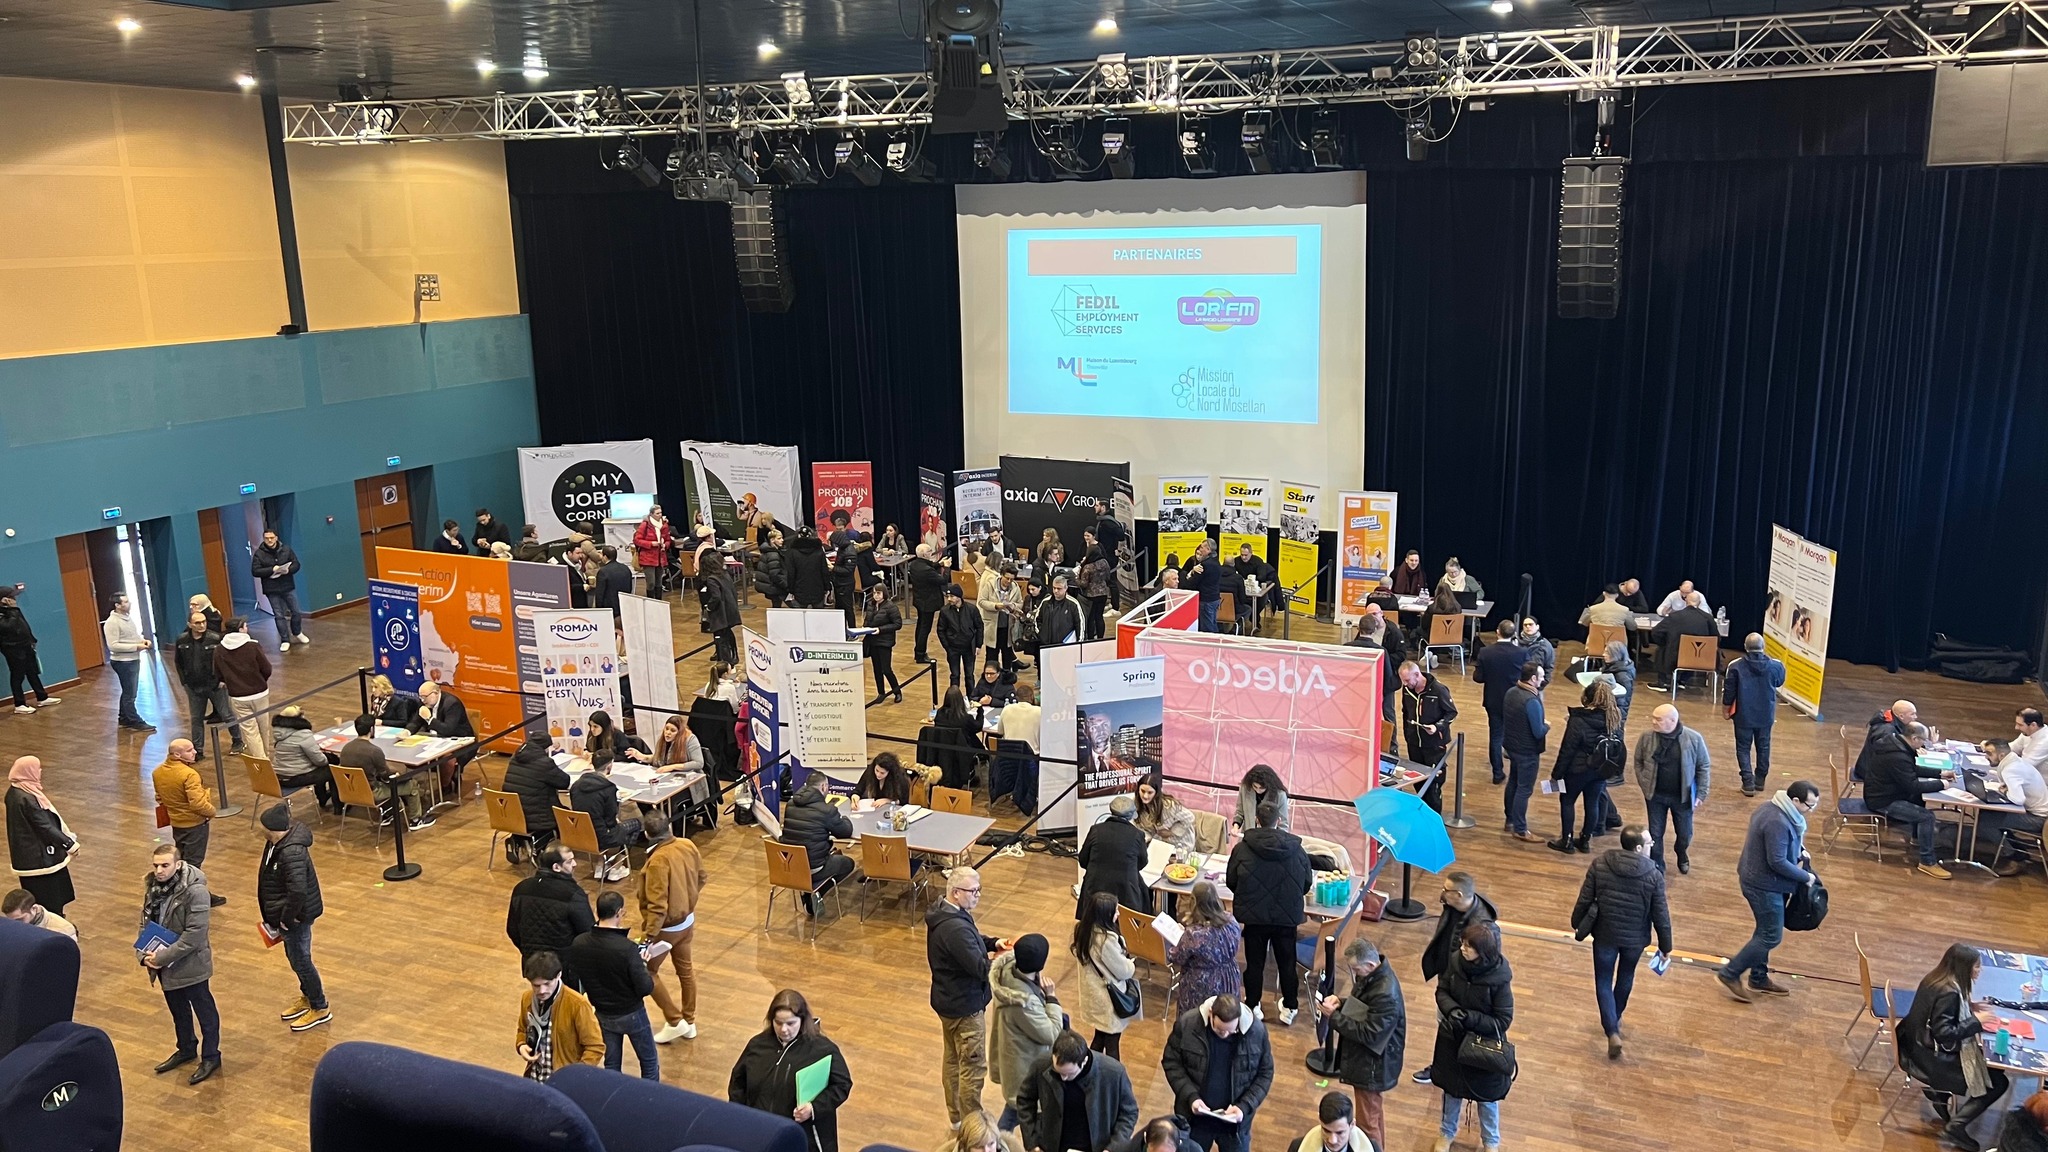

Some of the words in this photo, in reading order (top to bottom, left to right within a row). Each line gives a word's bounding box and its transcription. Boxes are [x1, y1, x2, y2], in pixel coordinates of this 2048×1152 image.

[1113, 248, 1202, 260] PARTENAIRES
[1076, 295, 1119, 309] FEDIL
[1076, 313, 1139, 322] EMPLOYMENT
[1076, 325, 1123, 334] SERVICES
[1198, 367, 1234, 382] Mission
[1198, 383, 1227, 397] Locale
[1229, 384, 1241, 397] du
[1197, 397, 1221, 411] Nord
[1223, 399, 1265, 413] Mosellan
[818, 487, 868, 497] PROCHAIN
[1168, 485, 1202, 494] Staff
[1229, 486, 1263, 496] Staff
[565, 490, 623, 508] JOB'
[831, 497, 853, 507] JOB
[856, 496, 864, 508] ?
[921, 493, 945, 509] PROCHAIN
[1004, 487, 1039, 503] axia
[1072, 495, 1115, 509] GROE
[1287, 491, 1315, 503] Staff
[566, 510, 612, 522] CORNE
[1778, 532, 1796, 547] Morgan
[1805, 547, 1827, 563] Morgan
[419, 567, 451, 581] Action
[532, 590, 558, 599] Agenturen
[550, 624, 598, 632] PROMAN
[1123, 670, 1156, 682] Spring
[546, 677, 605, 688] L'IMPORTANT
[546, 689, 571, 699] C'EST
[572, 687, 605, 708] Vous
[609, 687, 615, 707] !
[1084, 773, 1095, 781] THE
[1095, 769, 1133, 780] PROFESSIONAL
[1134, 766, 1152, 775] SPIRIT
[1084, 781, 1098, 789] THAT
[1098, 779, 1118, 788] DRIVES
[1119, 777, 1127, 785] US
[53, 1086, 69, 1107] M
